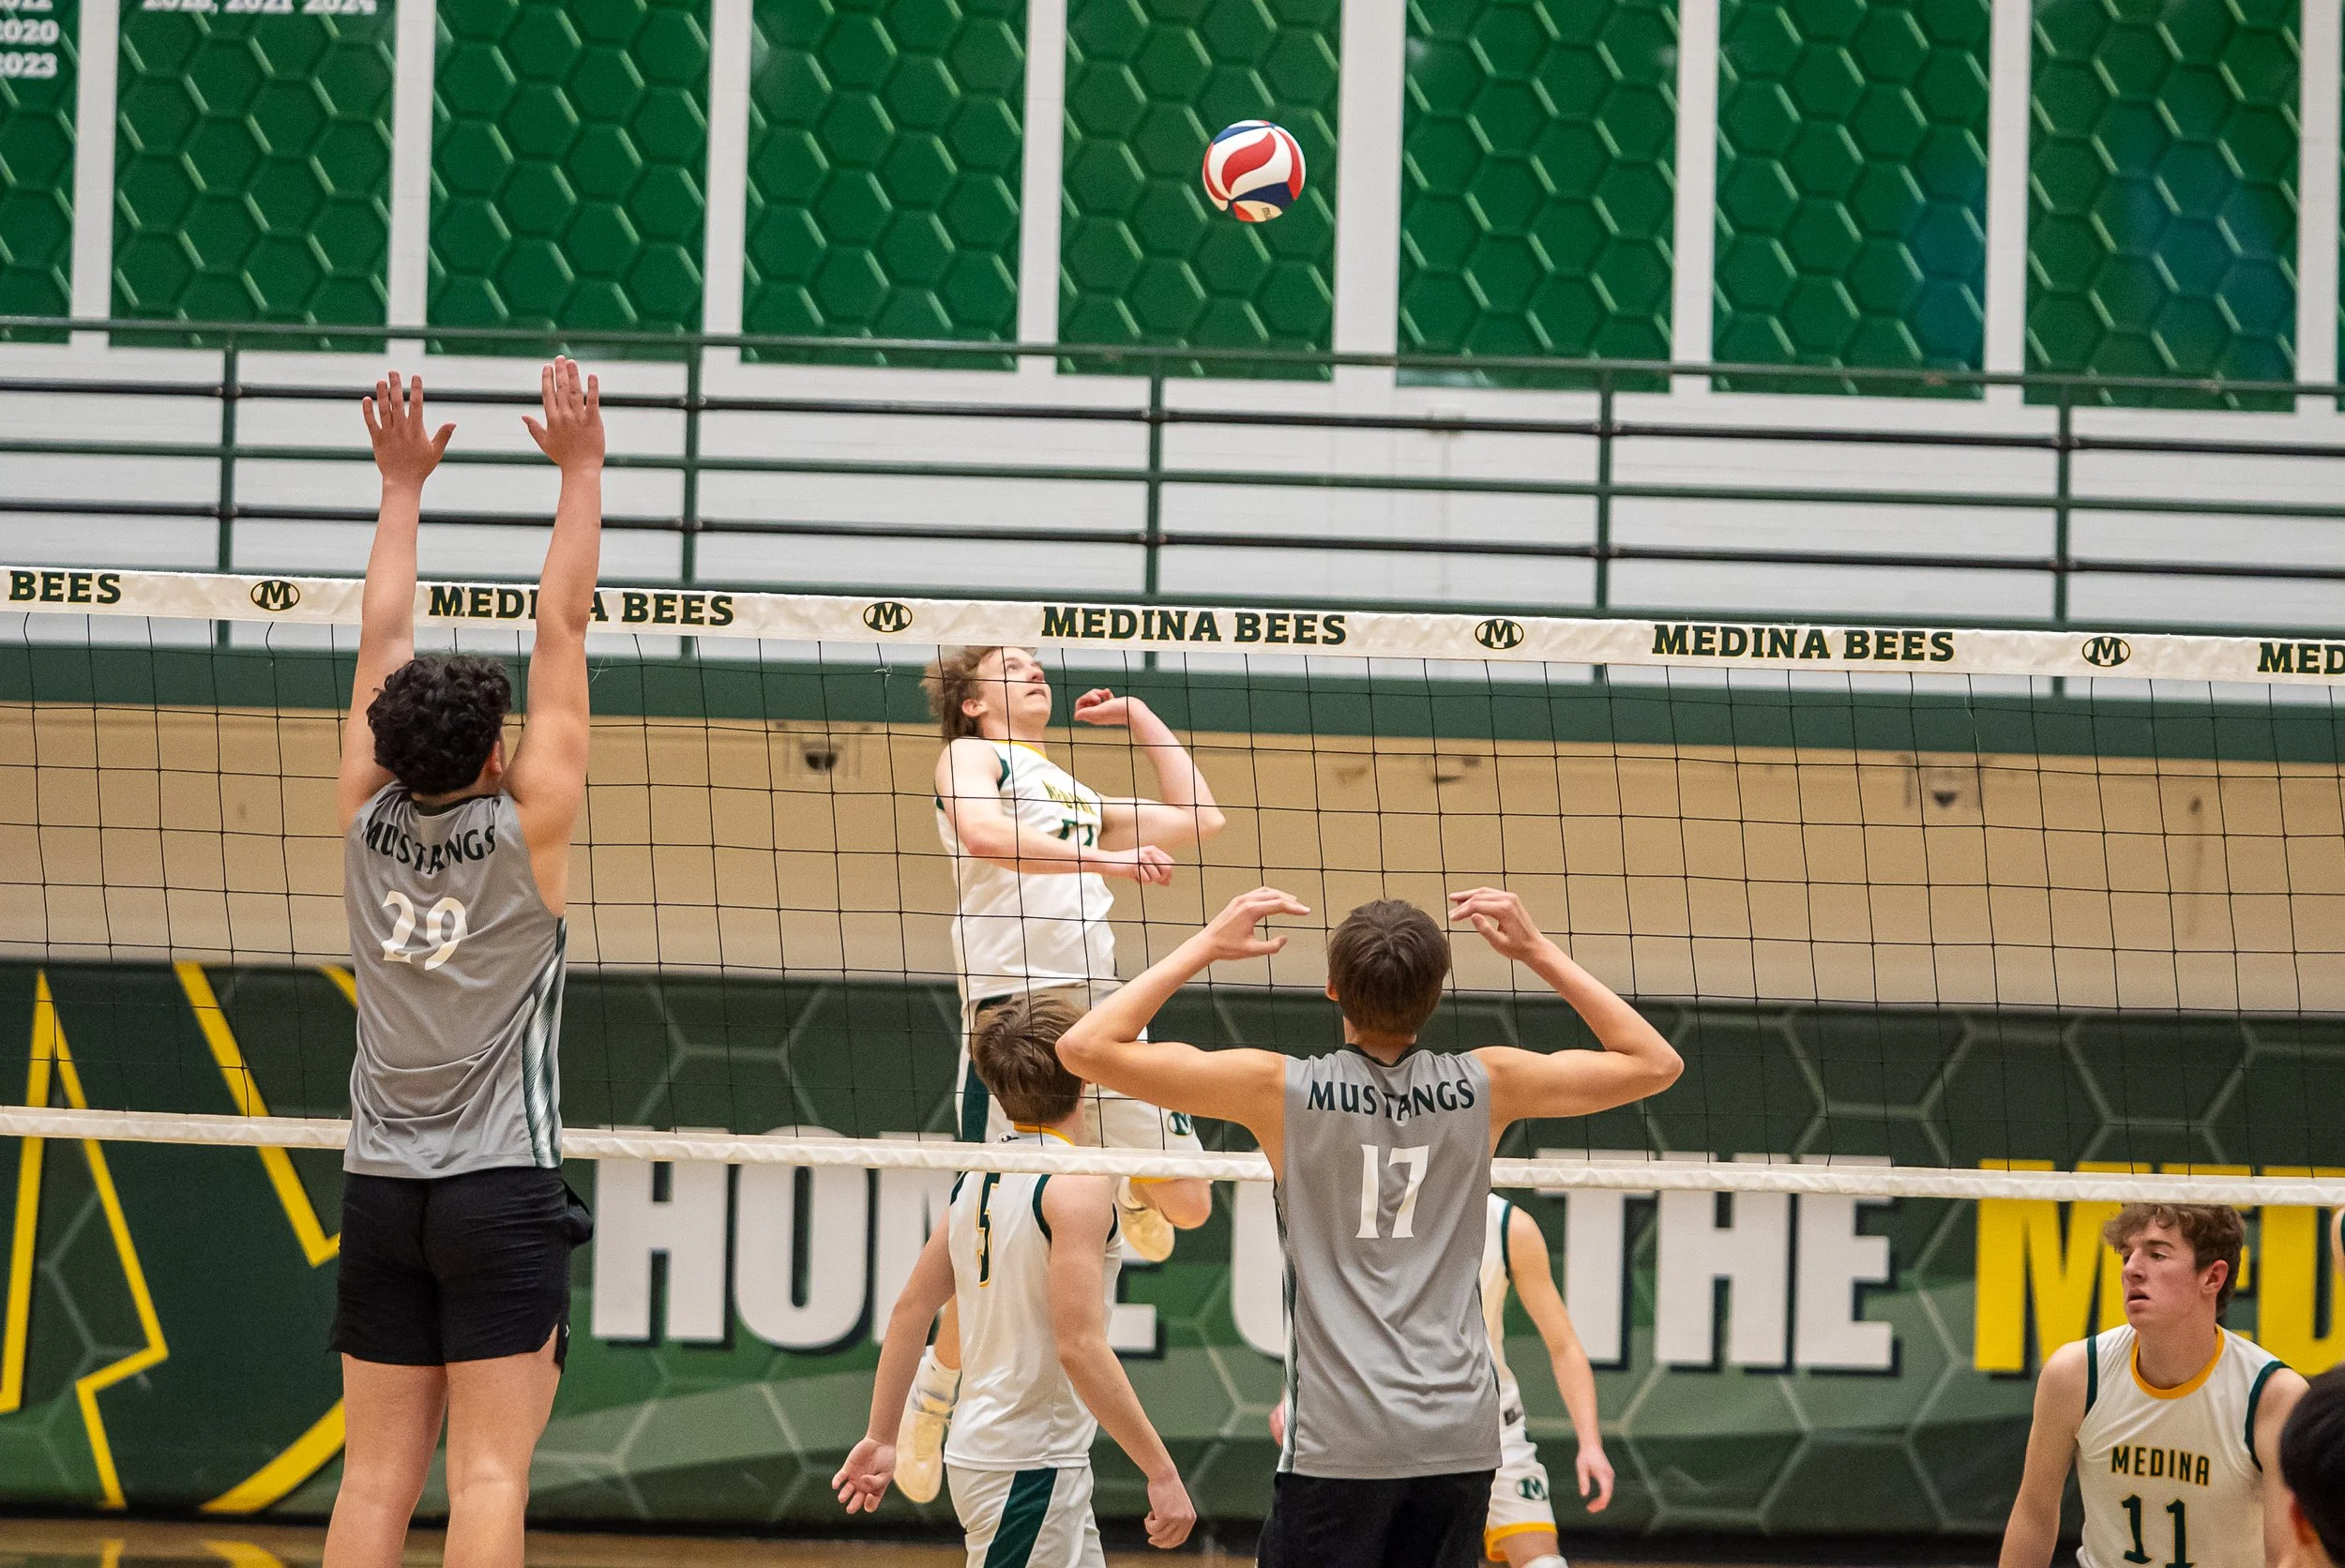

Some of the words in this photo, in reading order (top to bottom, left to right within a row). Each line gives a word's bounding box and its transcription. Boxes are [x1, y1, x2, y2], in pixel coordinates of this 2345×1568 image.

[0, 19, 59, 45] 020
[0, 52, 57, 78] 023
[8, 570, 122, 605] BEES
[259, 580, 293, 611] M
[621, 592, 734, 626] BEES
[869, 602, 907, 631] M
[1041, 606, 1221, 642] MEDINA
[1233, 611, 1347, 645] BEES
[1480, 619, 1518, 649] M
[1651, 624, 1831, 659] MEDINA
[1843, 629, 1955, 662] BEES
[2087, 637, 2126, 666] M
[361, 814, 496, 875] MUSTANGS
[381, 890, 469, 972] 29
[1307, 1078, 1475, 1122] MUSTANGS
[1354, 1143, 1430, 1239] 17
[1535, 1148, 1895, 1369] THE
[2110, 1444, 2211, 1486] MEDINA
[2121, 1493, 2196, 1568] 11
